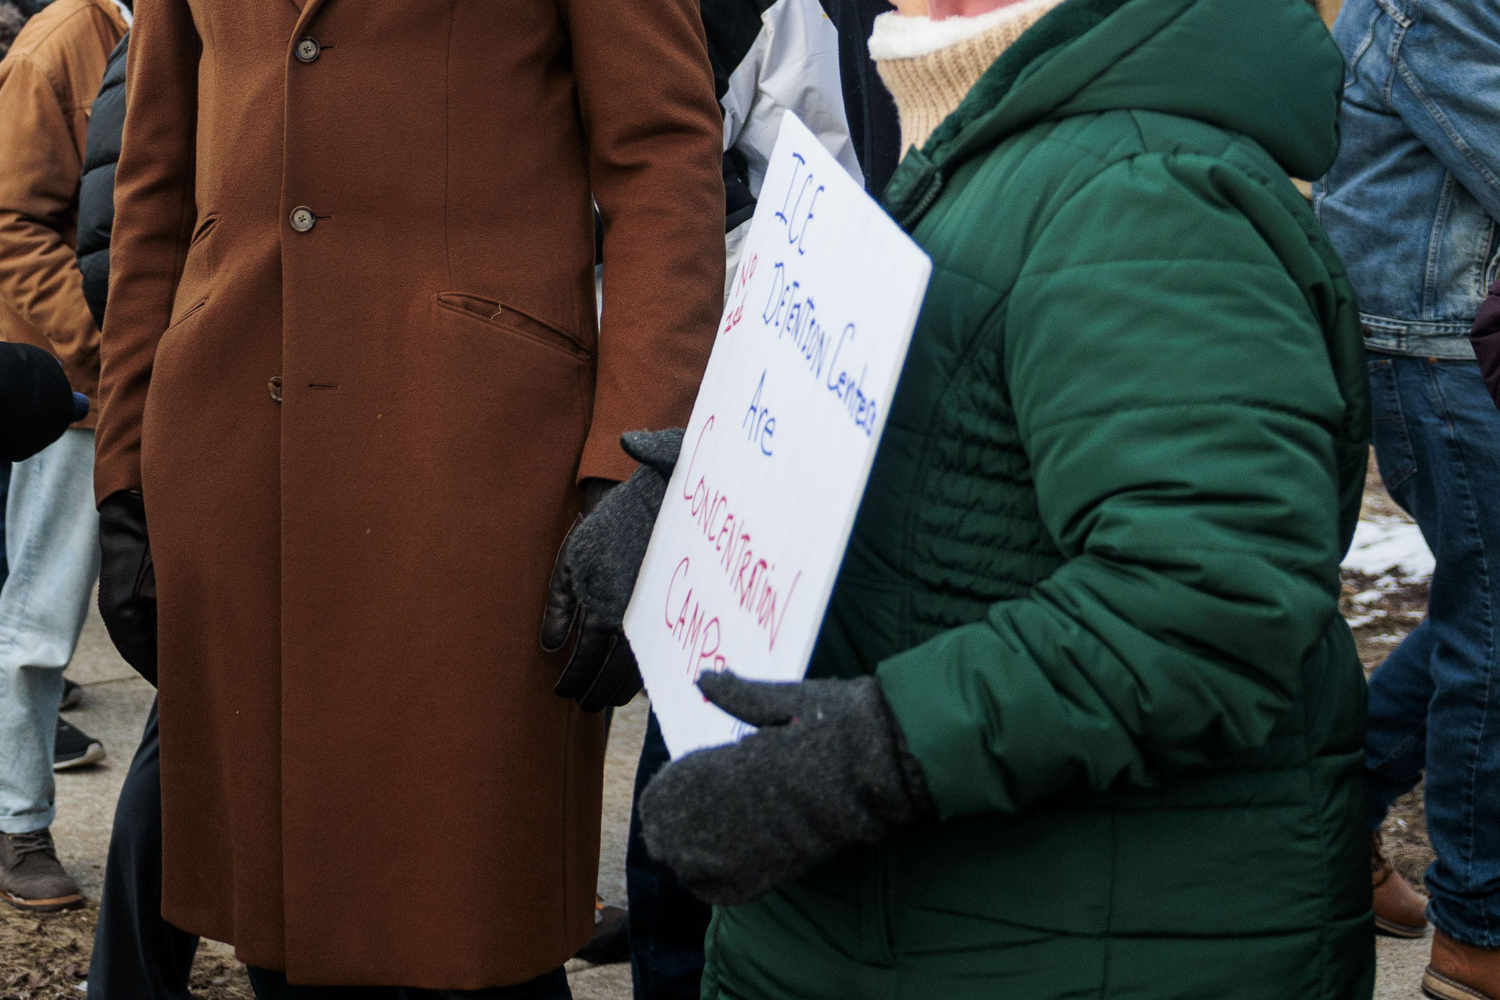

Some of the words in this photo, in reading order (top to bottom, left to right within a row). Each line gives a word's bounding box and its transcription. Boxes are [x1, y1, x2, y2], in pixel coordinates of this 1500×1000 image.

[775, 152, 825, 256] ICE
[762, 261, 832, 381] DETENTION
[742, 368, 776, 457] Are
